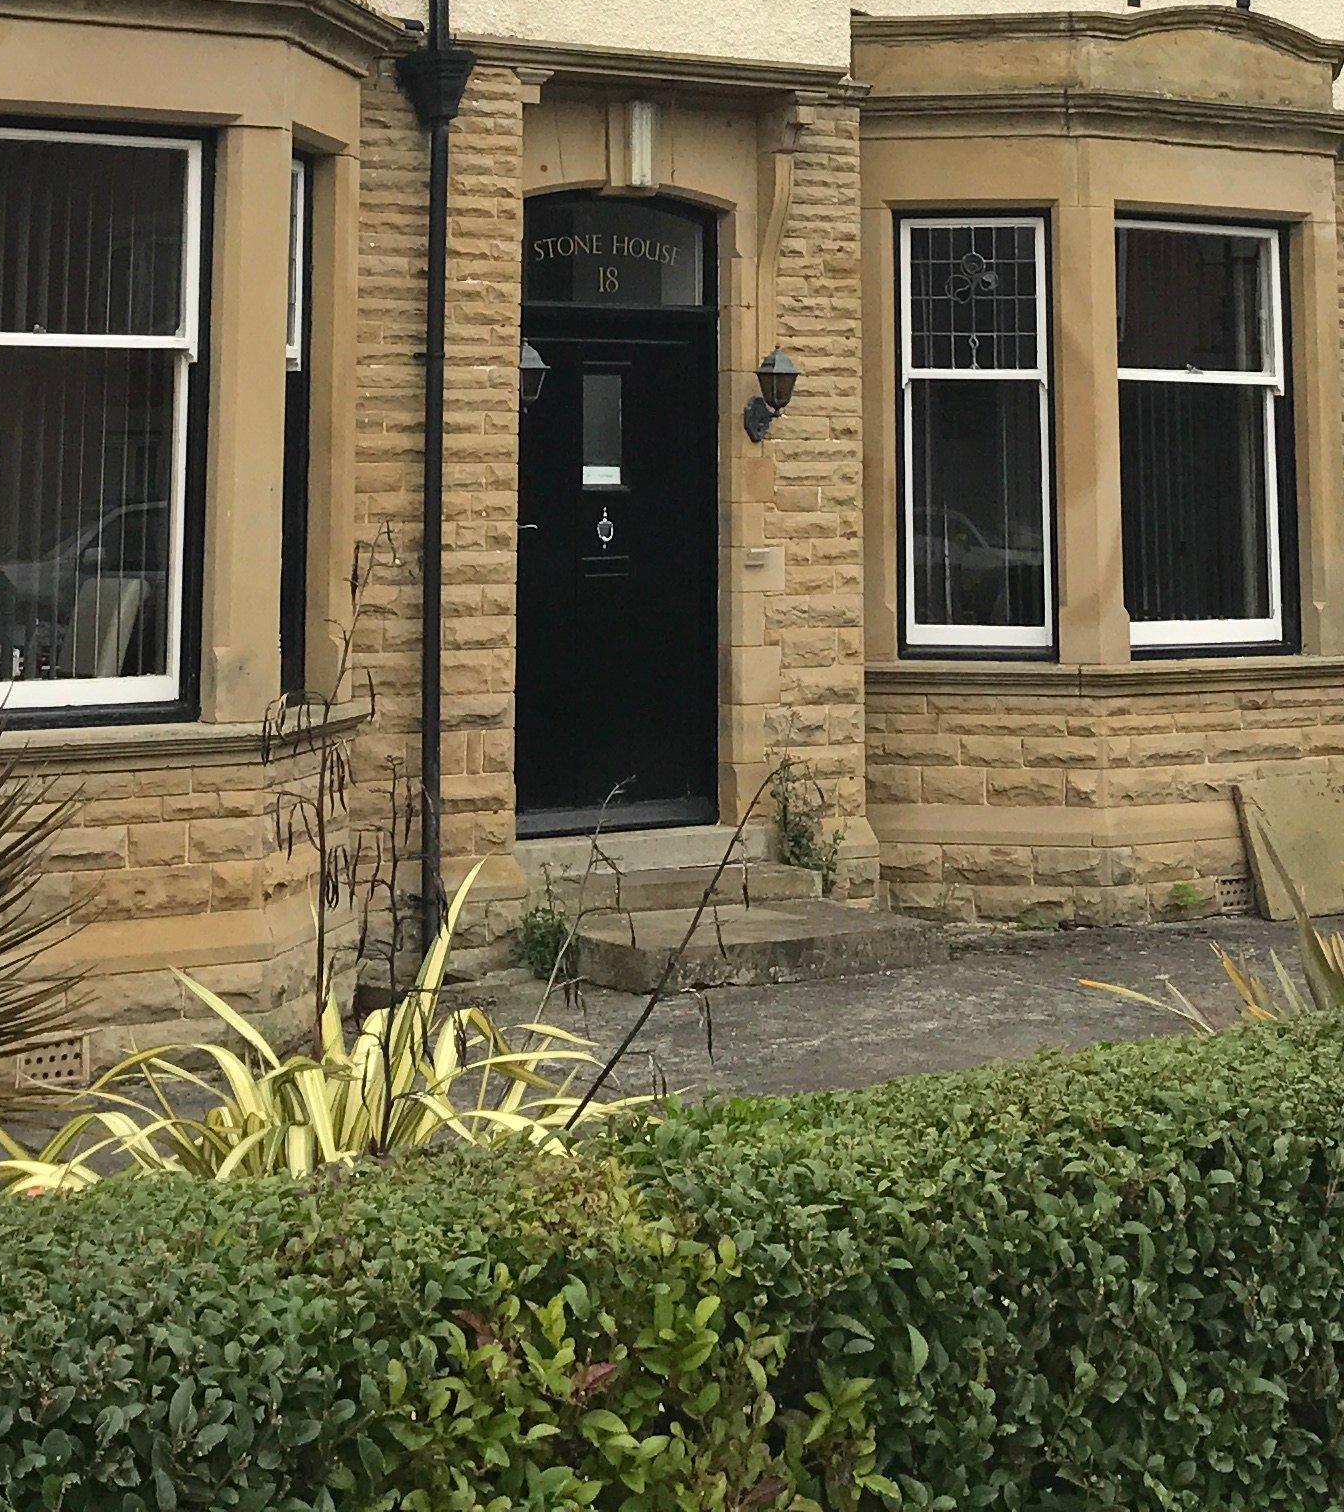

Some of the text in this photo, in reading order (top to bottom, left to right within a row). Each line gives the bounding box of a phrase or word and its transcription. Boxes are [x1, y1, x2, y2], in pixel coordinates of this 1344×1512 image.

[533, 234, 681, 265] STONE HOUSE
[598, 266, 619, 293] 18
